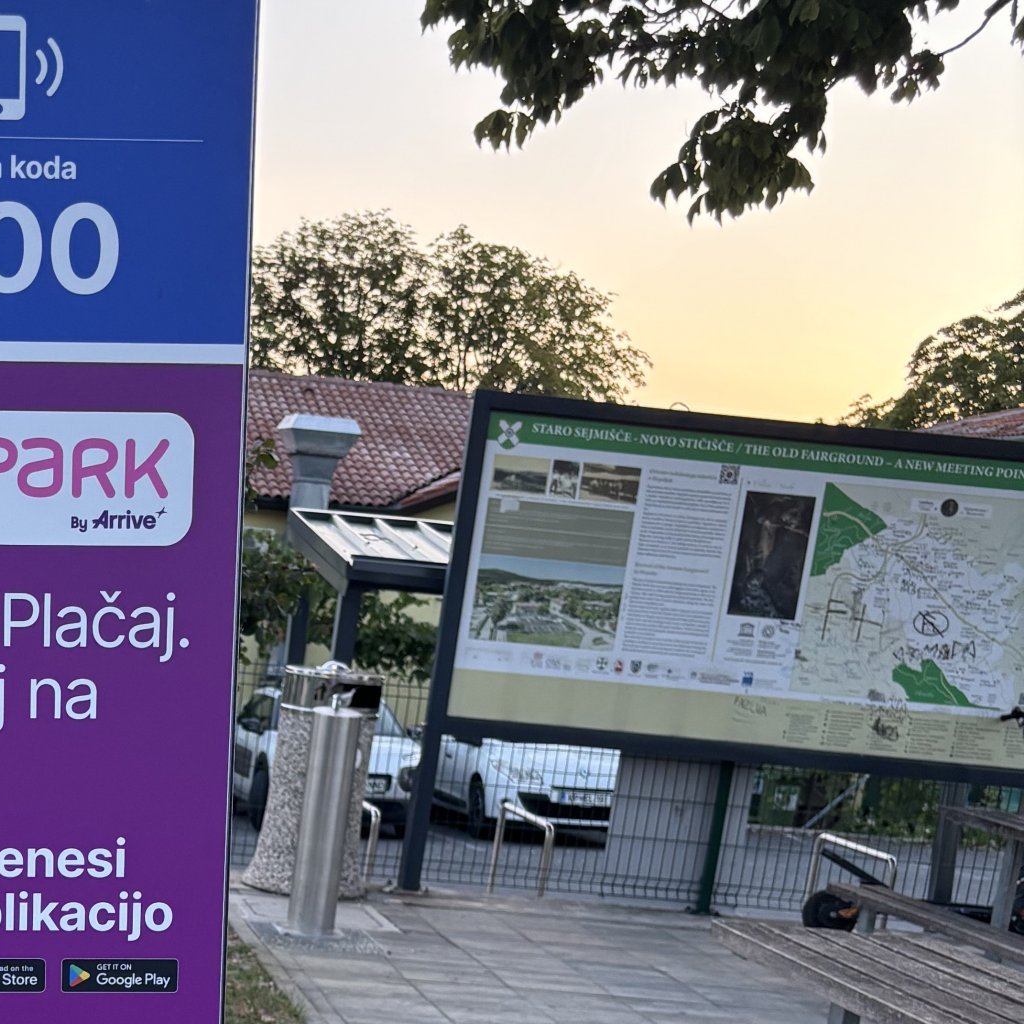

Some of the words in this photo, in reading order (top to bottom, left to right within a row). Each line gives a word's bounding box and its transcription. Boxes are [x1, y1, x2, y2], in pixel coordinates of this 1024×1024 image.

[10, 153, 77, 180] koda
[532, 423, 572, 437] STARO
[574, 427, 631, 442] SEJMIŠČE
[640, 434, 677, 447] NOVO
[745, 443, 770, 456] THE
[772, 447, 798, 459] OLD
[800, 450, 884, 467] FAIRGROUND
[894, 458, 904, 468] A
[905, 459, 935, 471] NEW
[936, 462, 994, 477] MEETING
[71, 515, 87, 533] By
[92, 509, 157, 531] Arrive
[3, 589, 190, 663] Plačaj.
[28, 677, 98, 720] na
[2, 974, 38, 985] Store
[97, 963, 111, 971] GET
[112, 963, 119, 971] IT
[120, 963, 132, 971] ON
[96, 973, 142, 988] Google
[145, 973, 170, 988] Play
